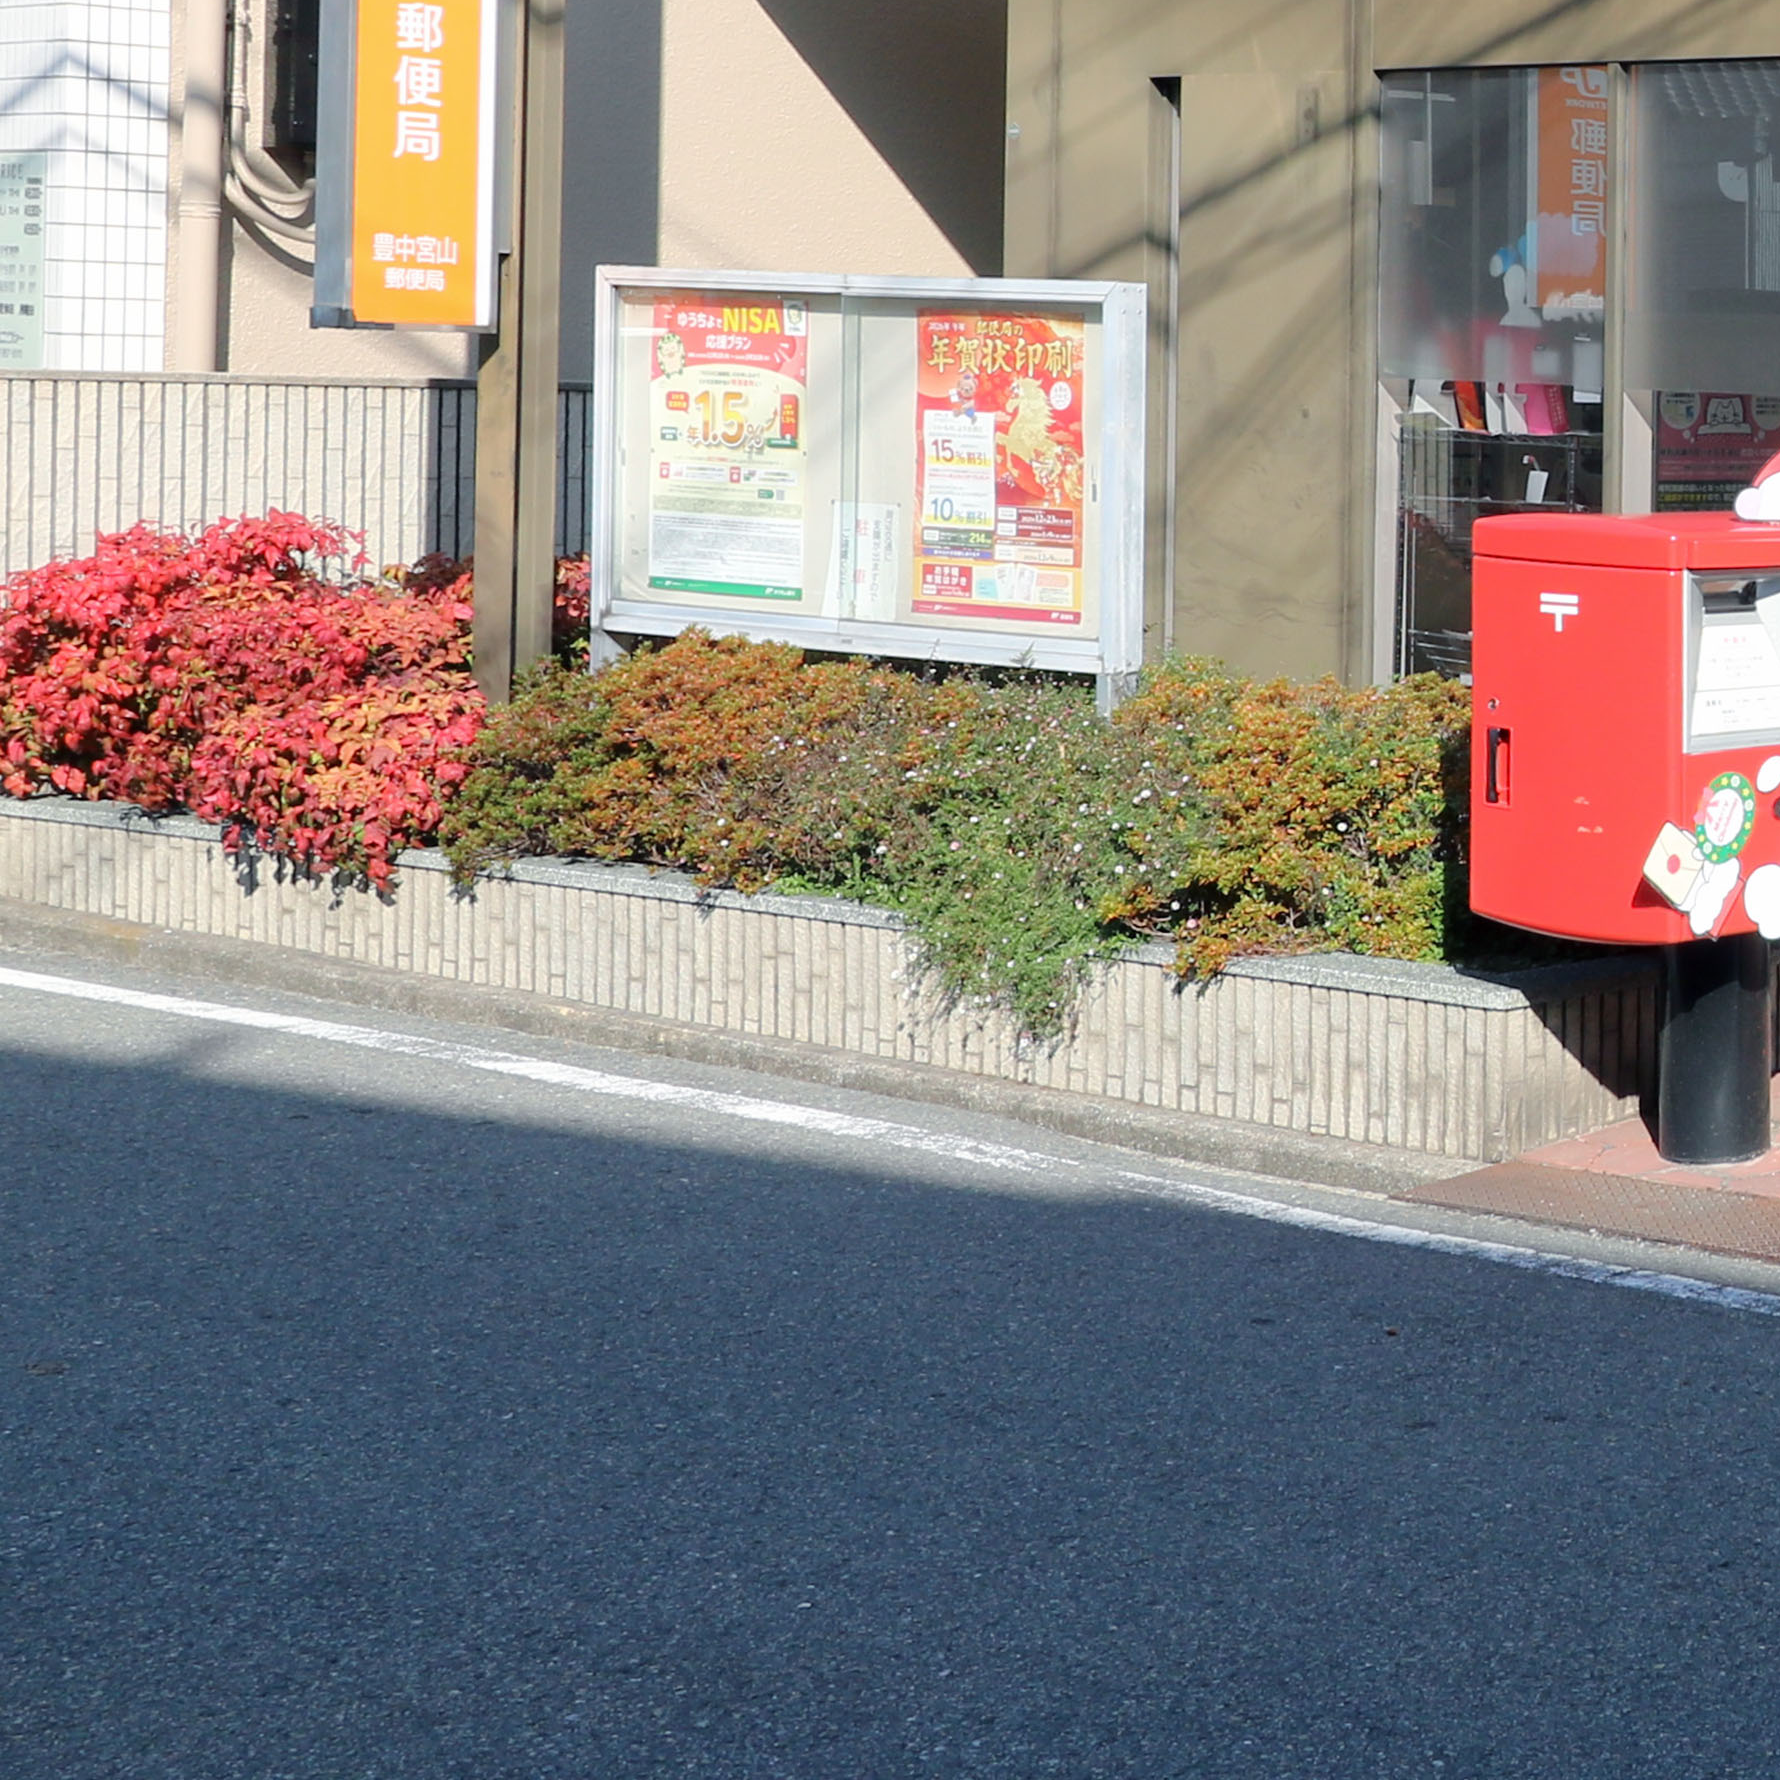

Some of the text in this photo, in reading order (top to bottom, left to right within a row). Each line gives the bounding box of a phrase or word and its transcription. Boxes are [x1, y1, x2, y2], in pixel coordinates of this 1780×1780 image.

[393, 1, 445, 162] 郵便局
[371, 231, 459, 266] 豊中宮山
[384, 266, 446, 293] 郵便局
[927, 334, 1074, 379] 年賀状印刷
